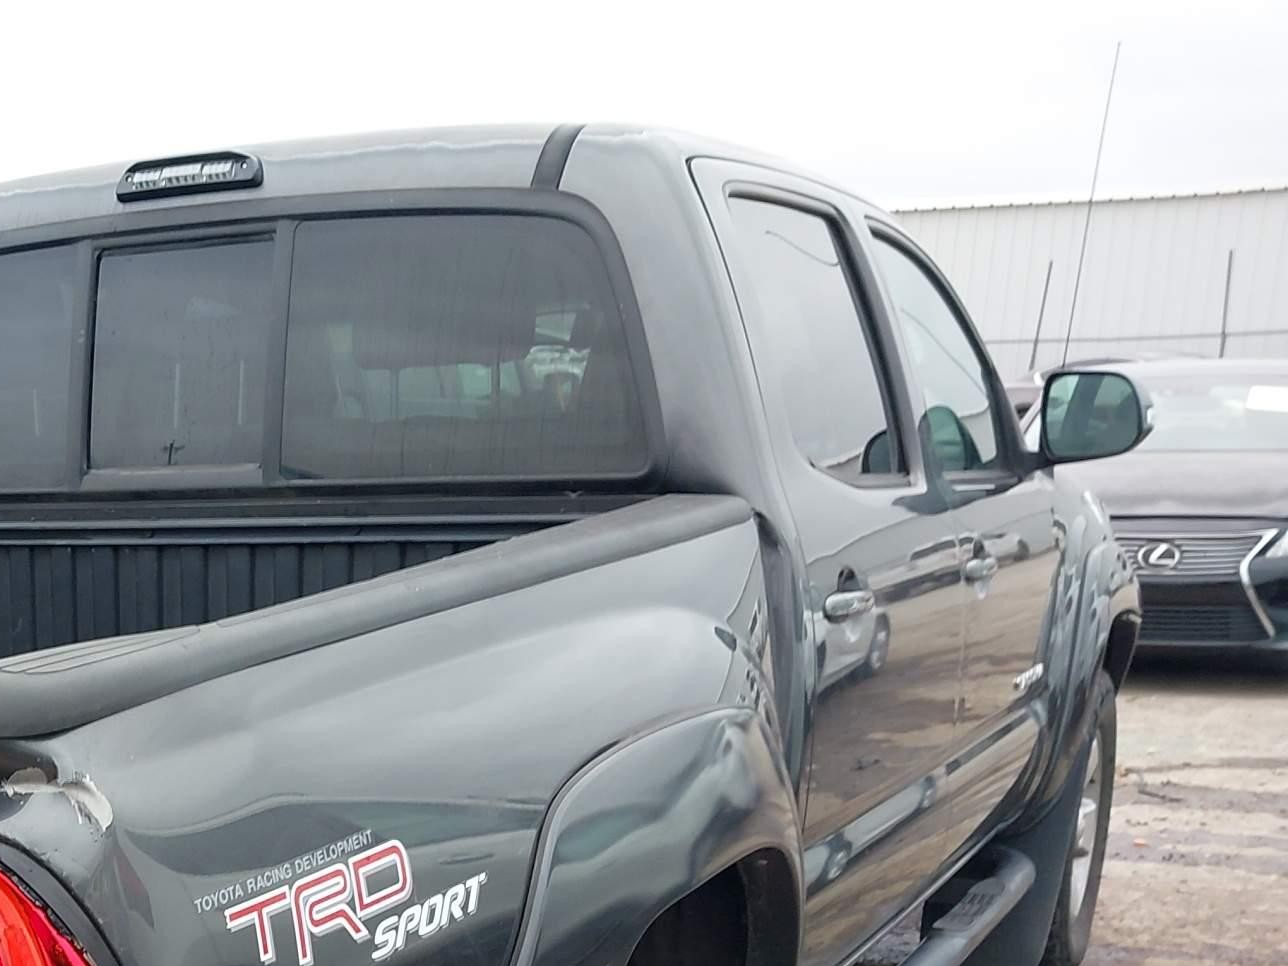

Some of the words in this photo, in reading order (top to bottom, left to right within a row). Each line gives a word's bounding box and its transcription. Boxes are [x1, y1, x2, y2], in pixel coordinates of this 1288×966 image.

[194, 879, 244, 914] TOYOTA
[246, 862, 292, 893] RACING
[295, 829, 374, 875] DEVELOPMENT
[371, 871, 489, 962] SPORT
